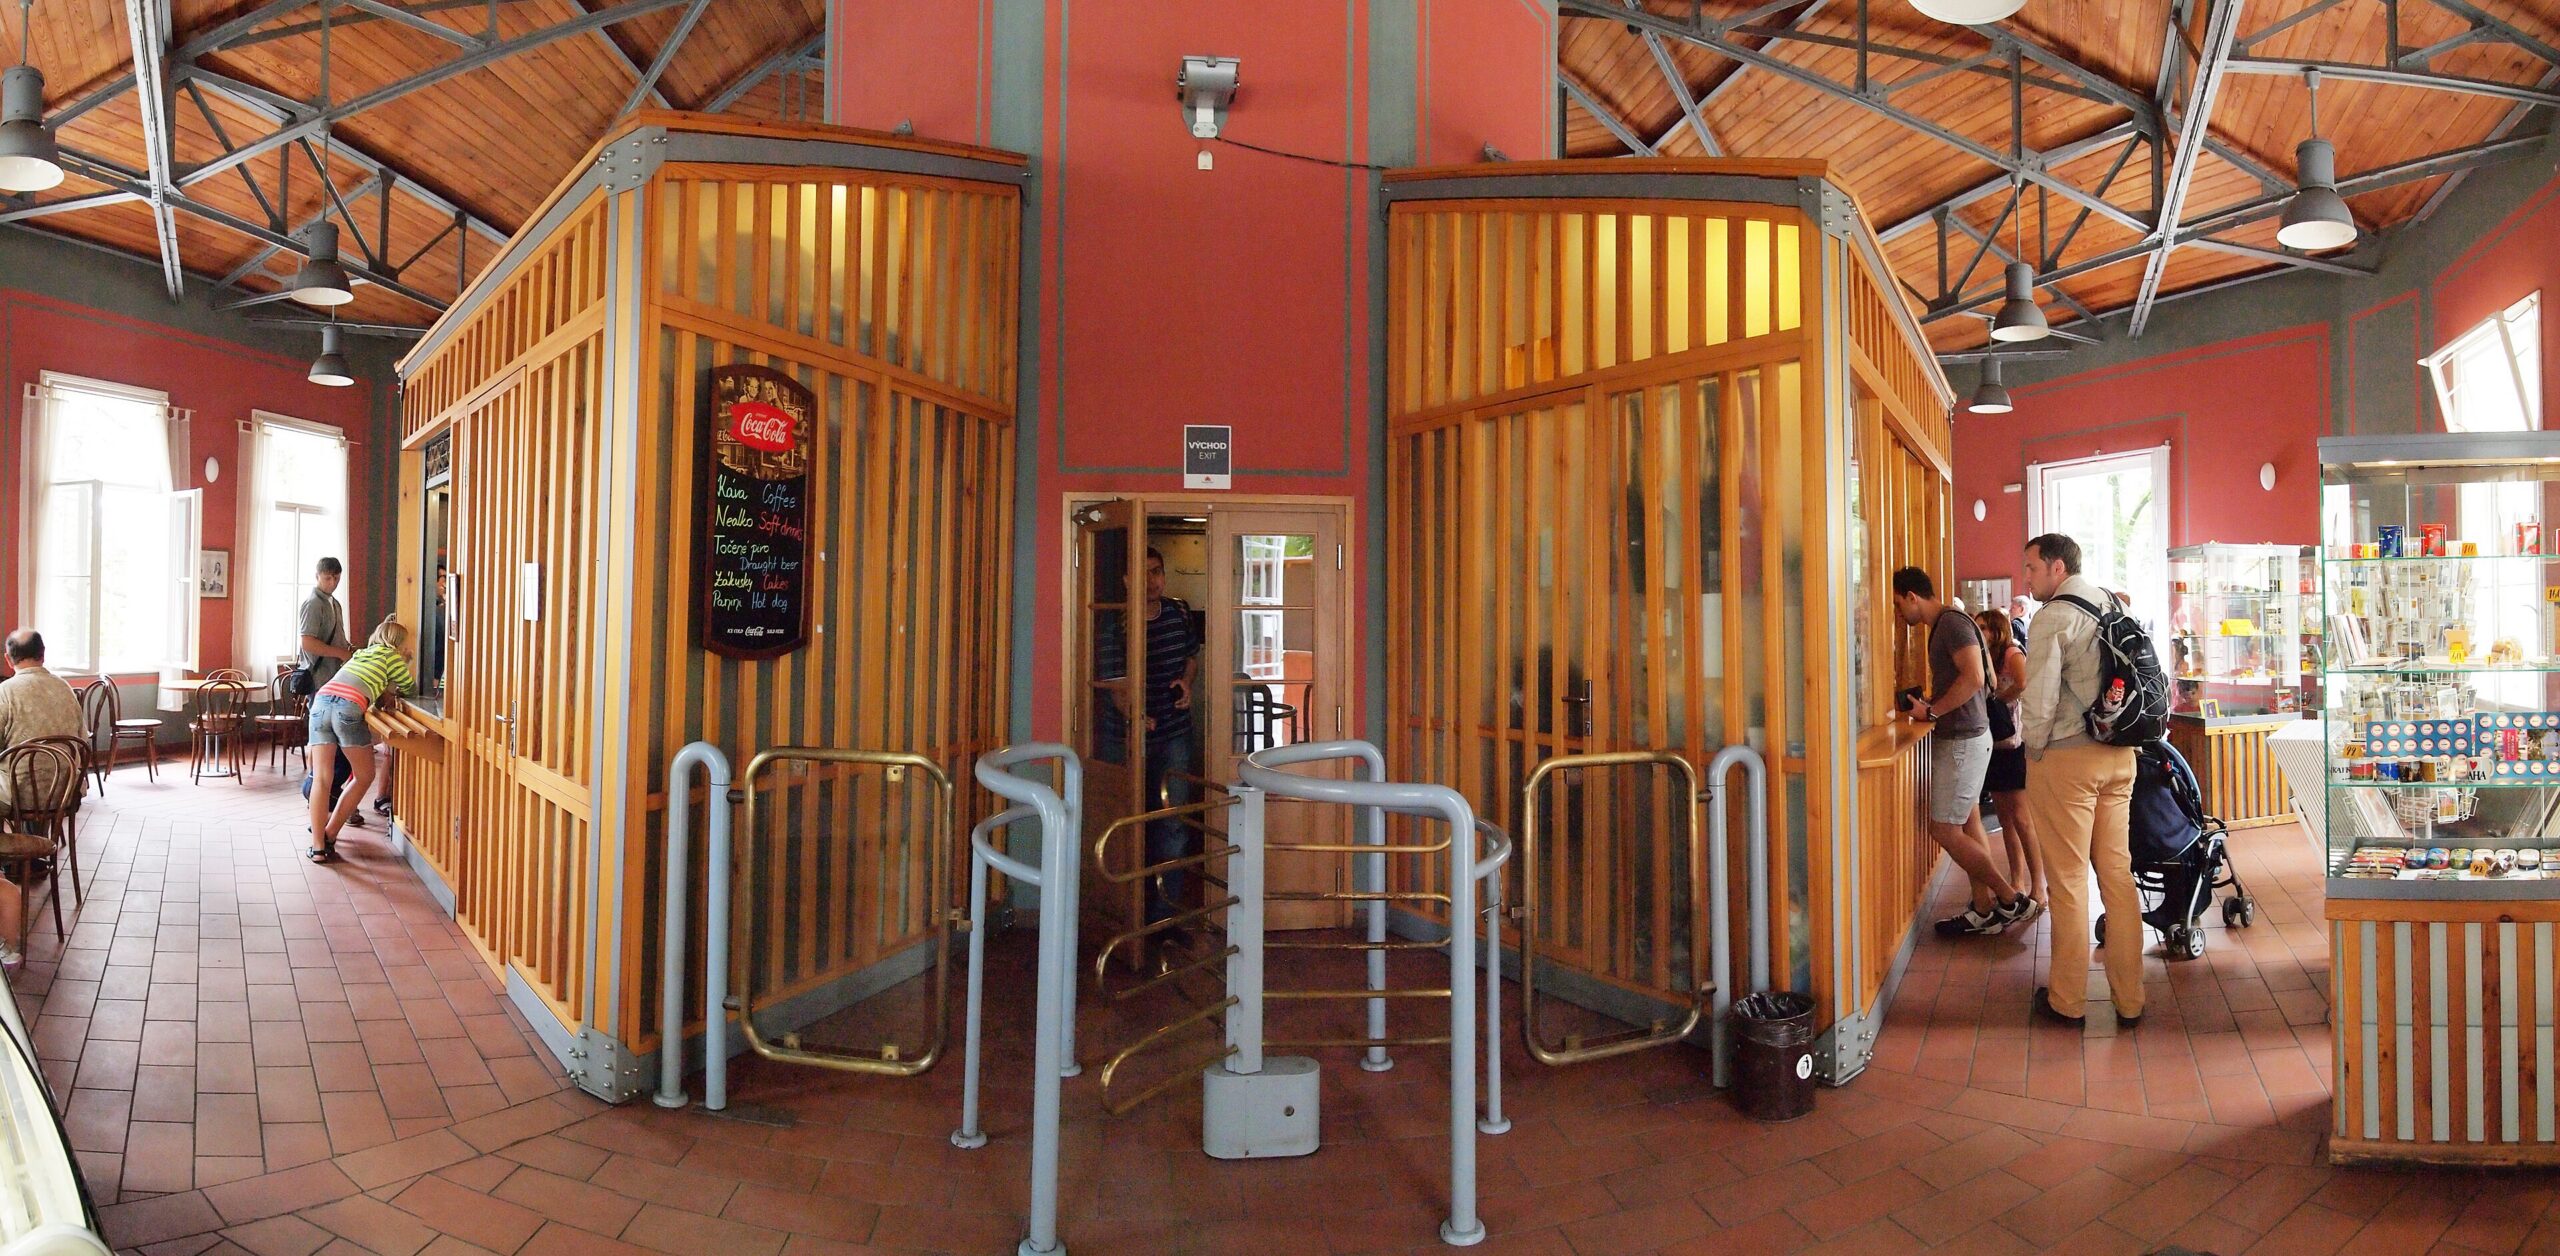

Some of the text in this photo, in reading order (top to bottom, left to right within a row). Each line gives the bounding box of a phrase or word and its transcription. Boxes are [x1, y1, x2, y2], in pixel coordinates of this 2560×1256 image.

[741, 412, 788, 444] Coca-Cola
[1188, 440, 1228, 450] VÝCHOD
[1199, 451, 1217, 460] EXIT
[717, 474, 796, 512] Káva Coffee
[715, 504, 754, 528] Nealko
[759, 511, 781, 536] Soft
[740, 555, 799, 576] Draught beer
[763, 574, 789, 590] Cakes
[712, 590, 788, 613] Panini Hot dog
